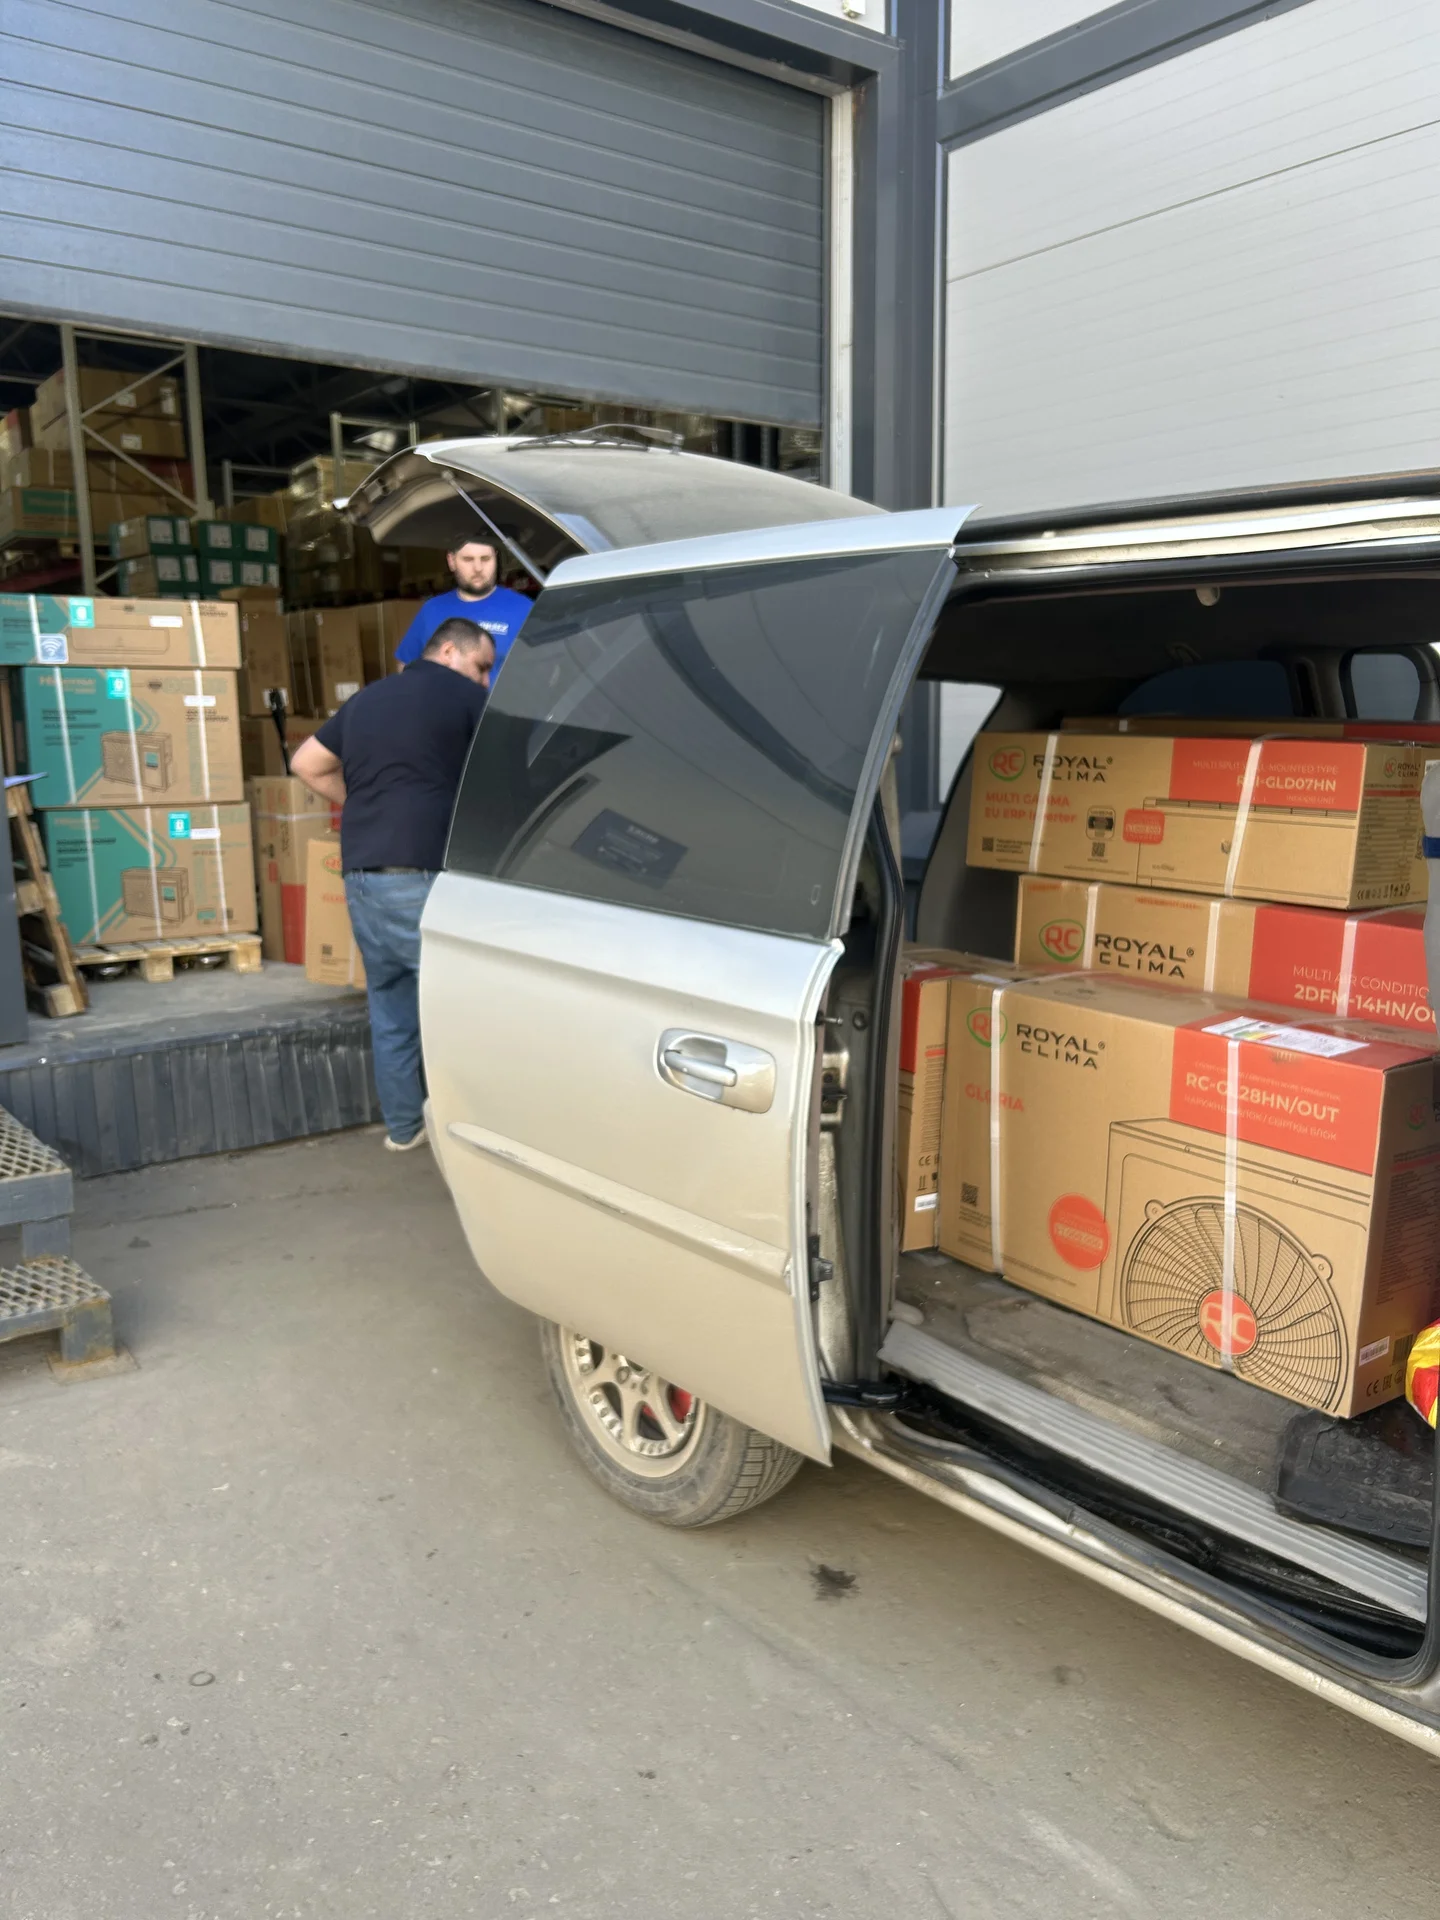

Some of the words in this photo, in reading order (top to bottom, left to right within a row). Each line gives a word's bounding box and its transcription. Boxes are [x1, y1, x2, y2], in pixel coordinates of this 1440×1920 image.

[1236, 774, 1337, 793] RI-GLD07HN
[985, 791, 1020, 804] MULTI
[1023, 793, 1070, 807] GAMA
[1099, 952, 1185, 979] CLIMA
[1293, 965, 1331, 982] MULTI
[1021, 1041, 1097, 1069] CLIMA
